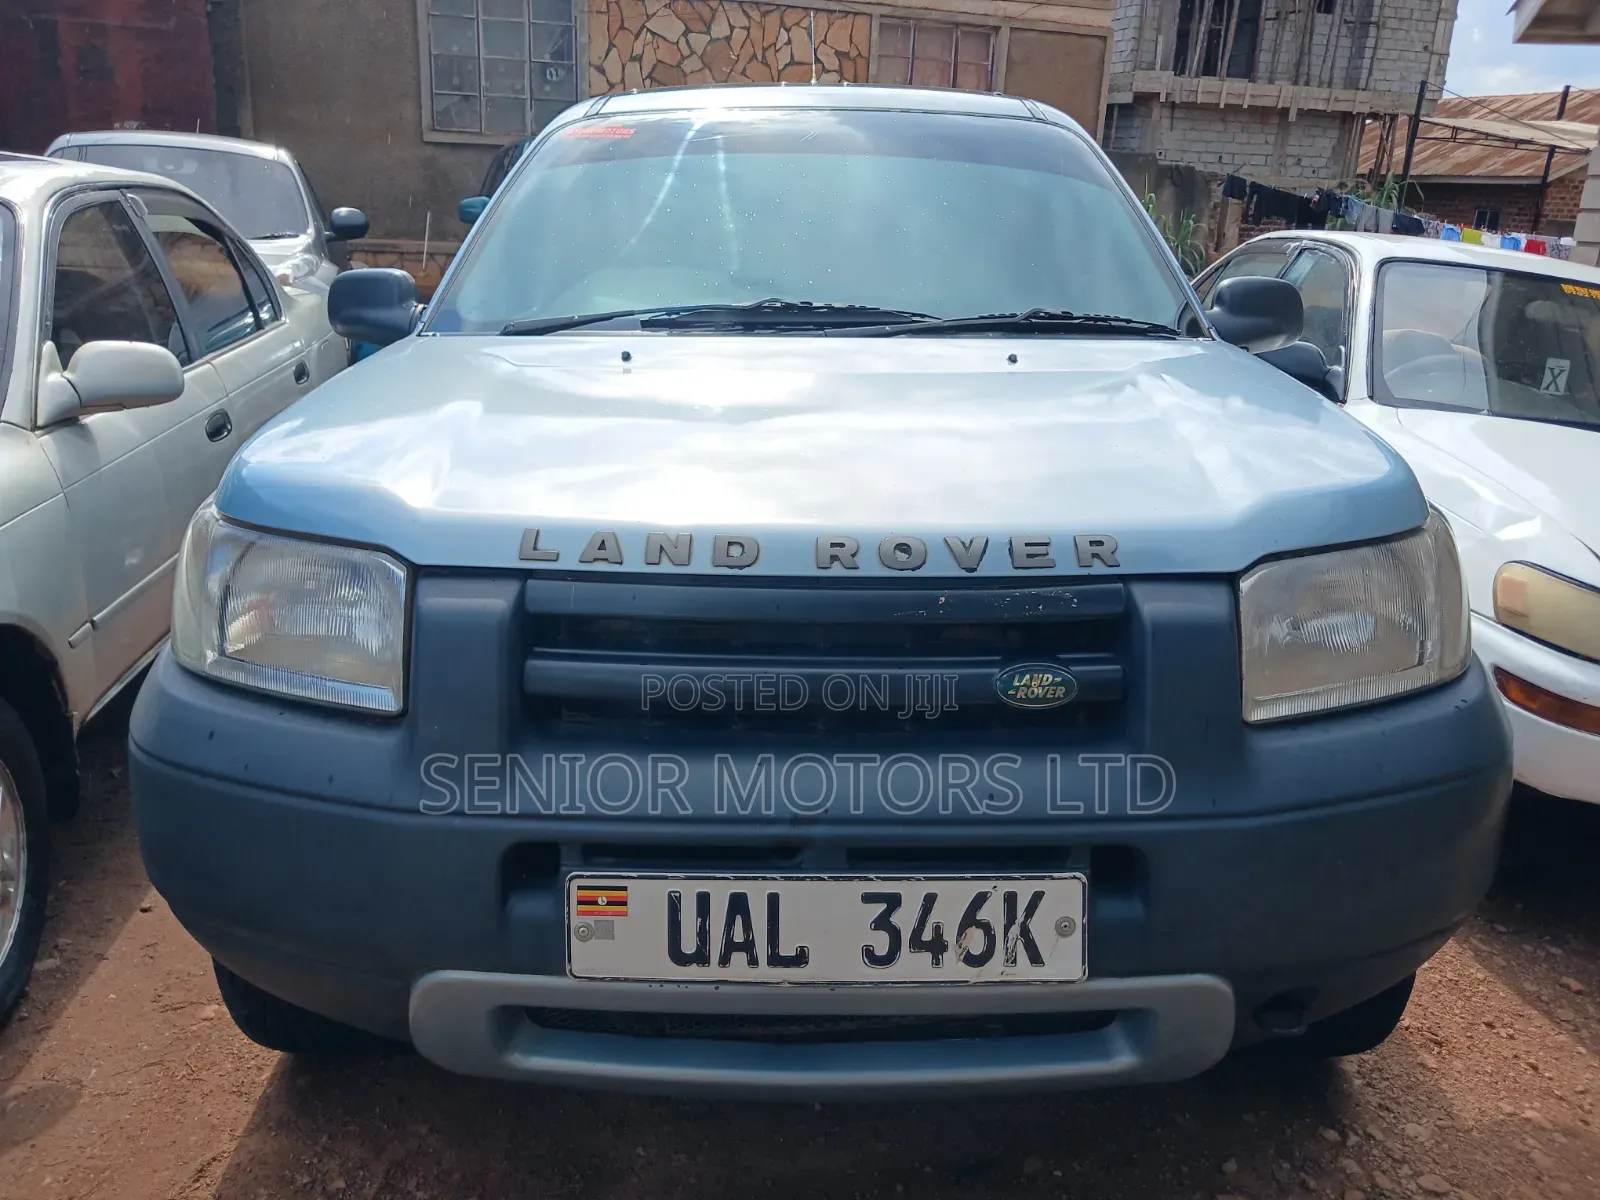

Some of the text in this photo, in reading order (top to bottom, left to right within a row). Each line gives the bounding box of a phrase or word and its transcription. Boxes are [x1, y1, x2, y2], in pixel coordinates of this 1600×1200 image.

[1542, 367, 1566, 392] X
[519, 527, 1121, 572] LAND ROVER
[667, 888, 1047, 969] UAL 346K
